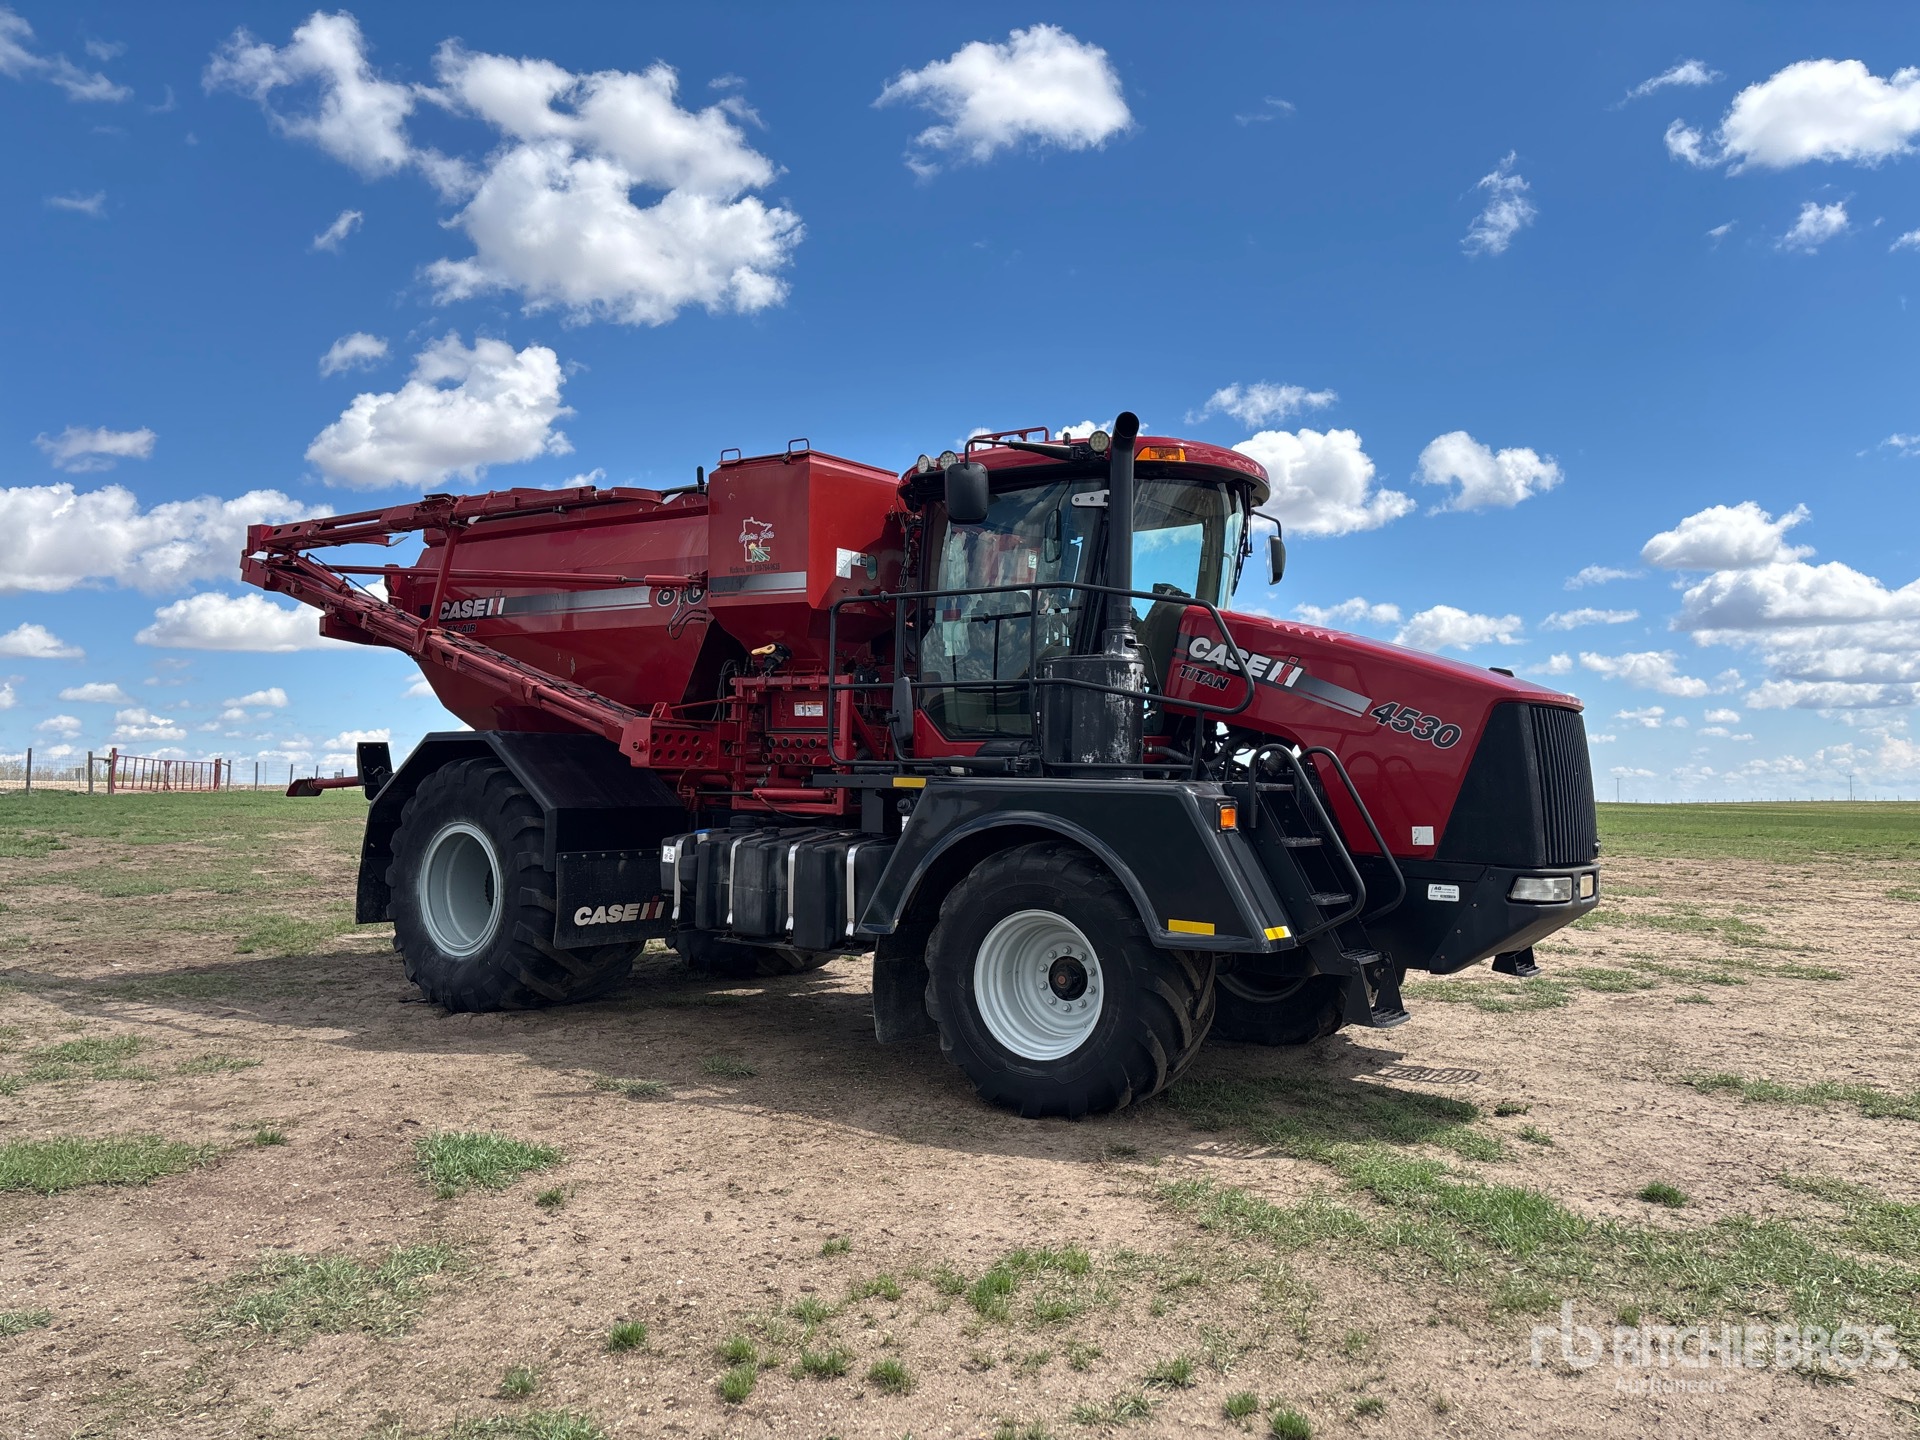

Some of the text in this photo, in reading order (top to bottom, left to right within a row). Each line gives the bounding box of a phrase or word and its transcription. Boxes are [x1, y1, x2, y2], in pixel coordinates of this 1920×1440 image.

[439, 598, 486, 620] CASE
[1189, 637, 1272, 678] CASE
[1179, 664, 1231, 692] TITAN
[1369, 701, 1463, 750] 4530
[573, 903, 641, 927] CASE
